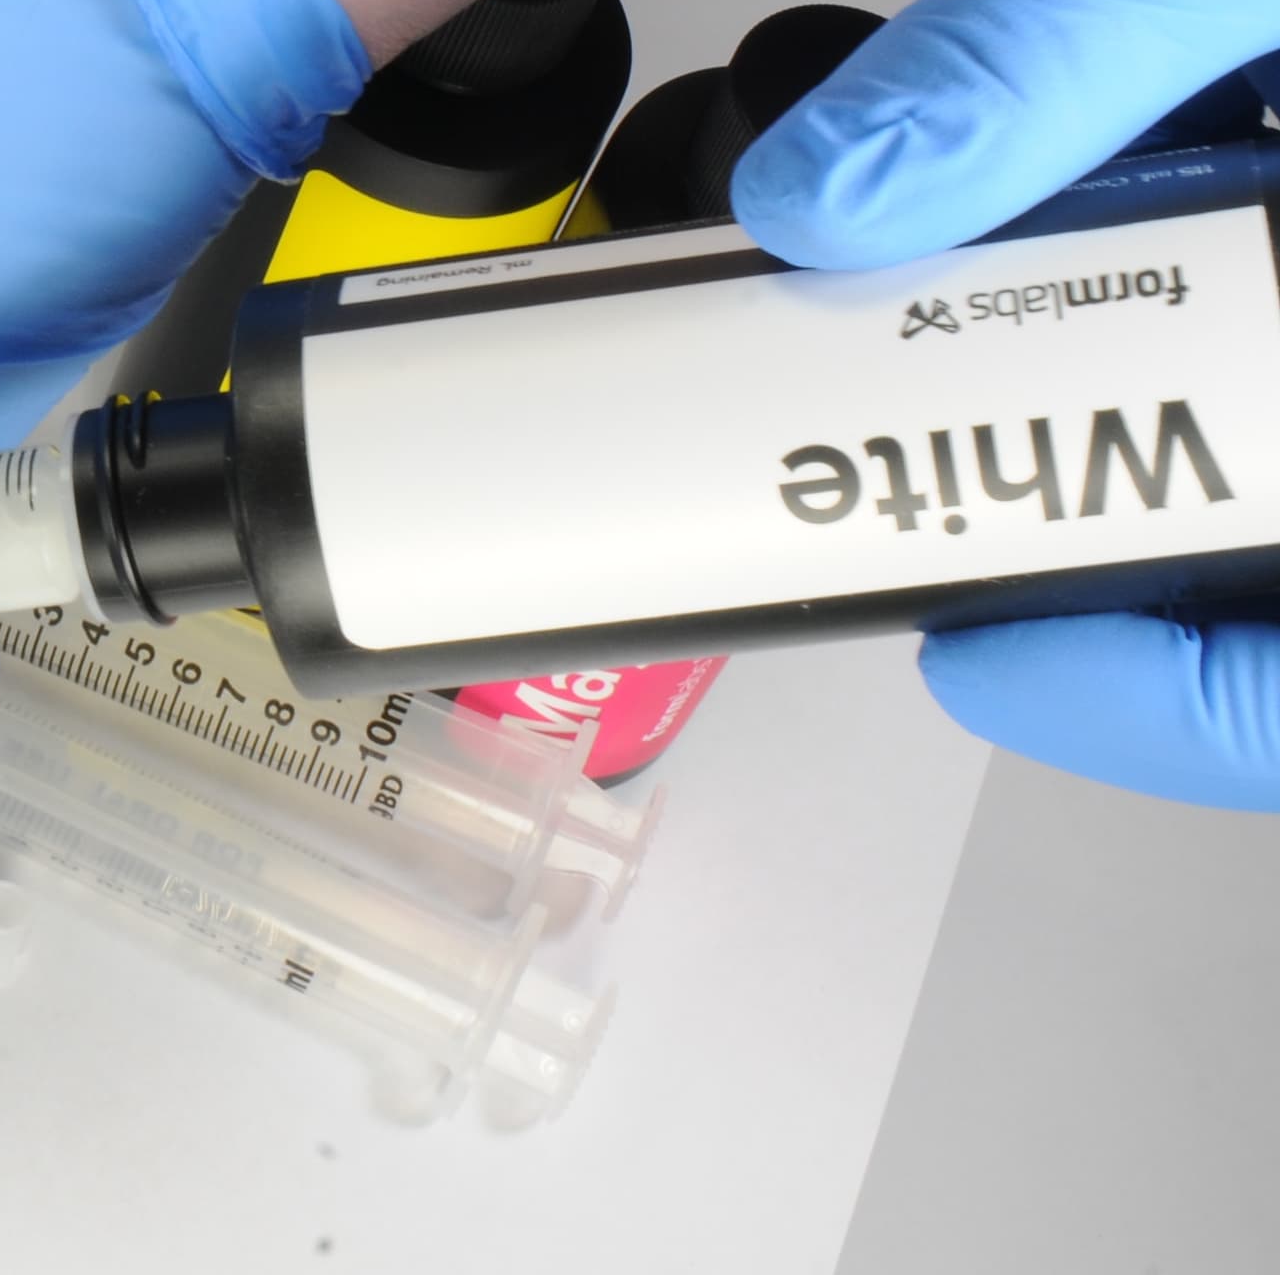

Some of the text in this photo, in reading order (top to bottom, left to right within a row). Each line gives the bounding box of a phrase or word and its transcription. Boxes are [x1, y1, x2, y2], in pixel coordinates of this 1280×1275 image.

[376, 265, 494, 287] Remaining
[966, 265, 1191, 325] formlabs
[779, 399, 1237, 536] White
[32, 604, 64, 627] 3
[81, 619, 111, 646] 4
[124, 637, 156, 667] 5
[171, 658, 203, 686] 6
[215, 676, 247, 704] 7
[264, 698, 296, 727] 8
[310, 718, 342, 747] 9
[358, 692, 415, 763] 10m
